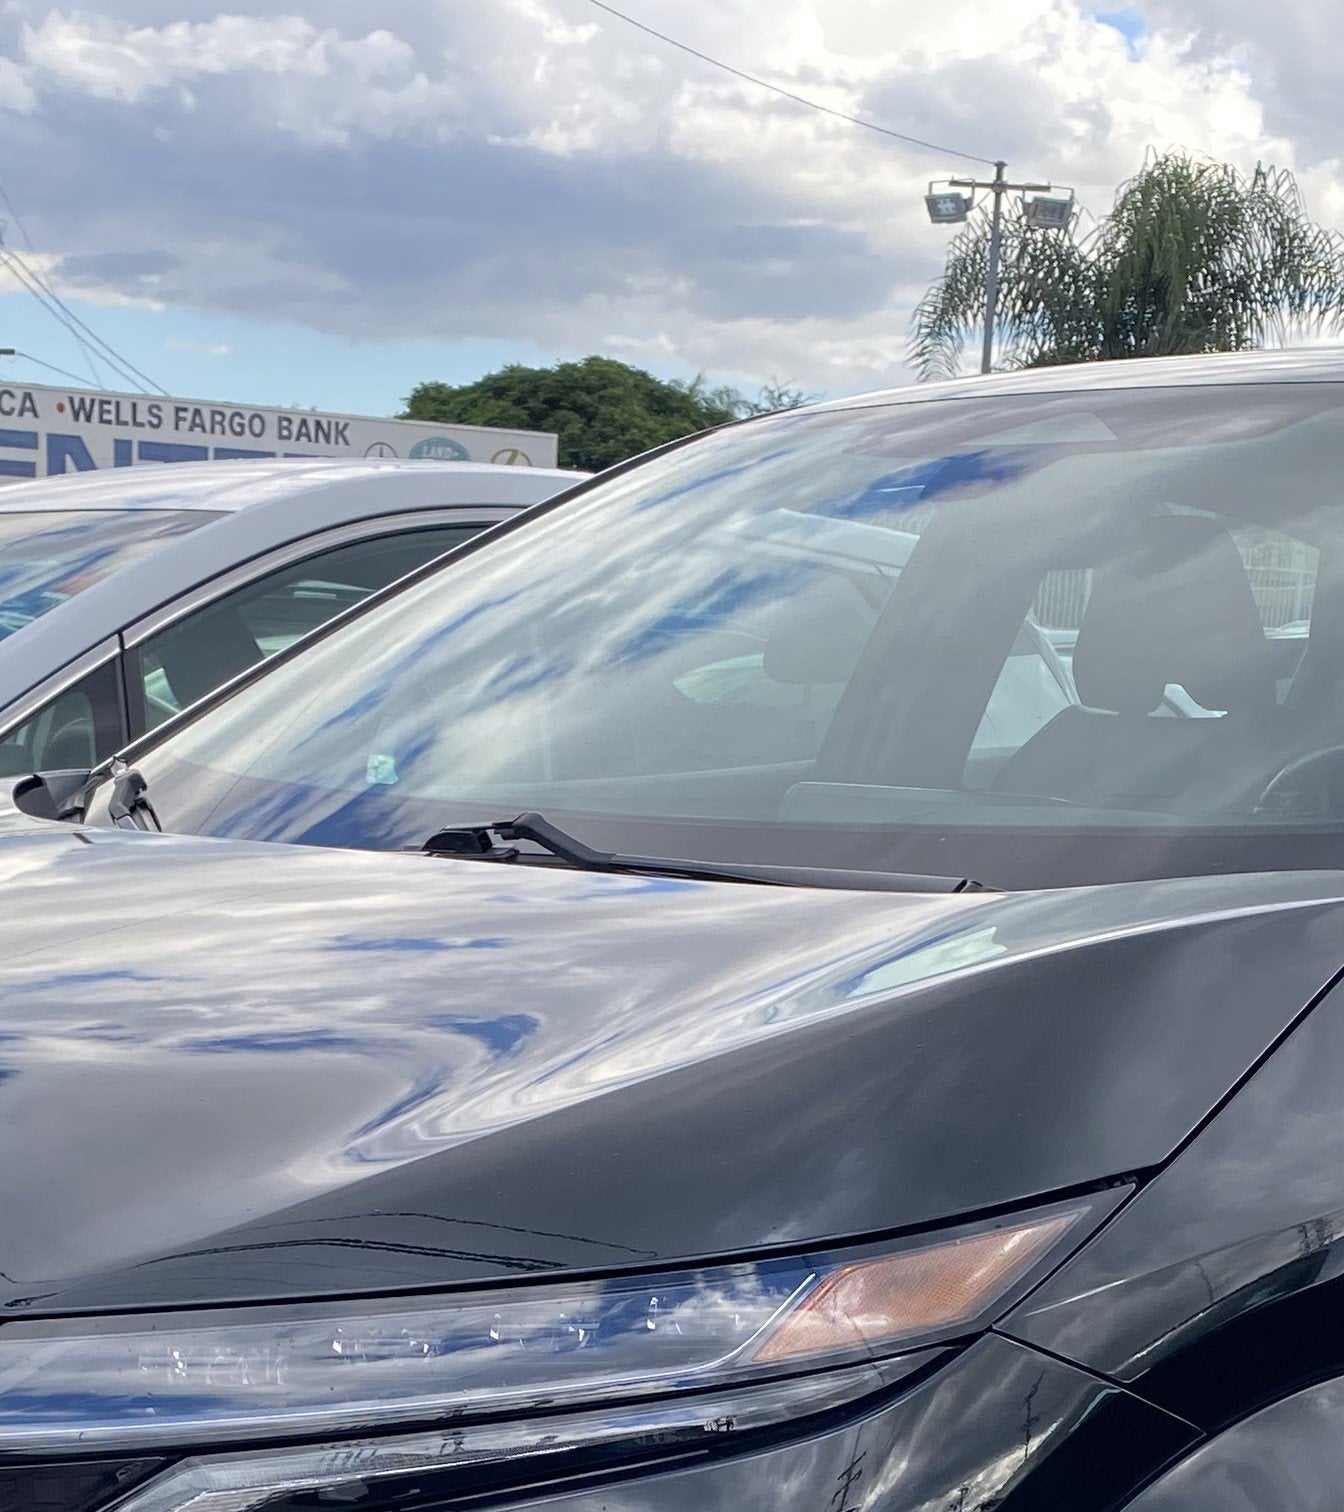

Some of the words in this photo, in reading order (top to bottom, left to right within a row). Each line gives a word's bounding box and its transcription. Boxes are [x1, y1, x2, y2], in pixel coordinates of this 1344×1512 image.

[67, 396, 163, 430] WELLS
[173, 406, 266, 439] FARGO
[277, 415, 351, 447] BANK
